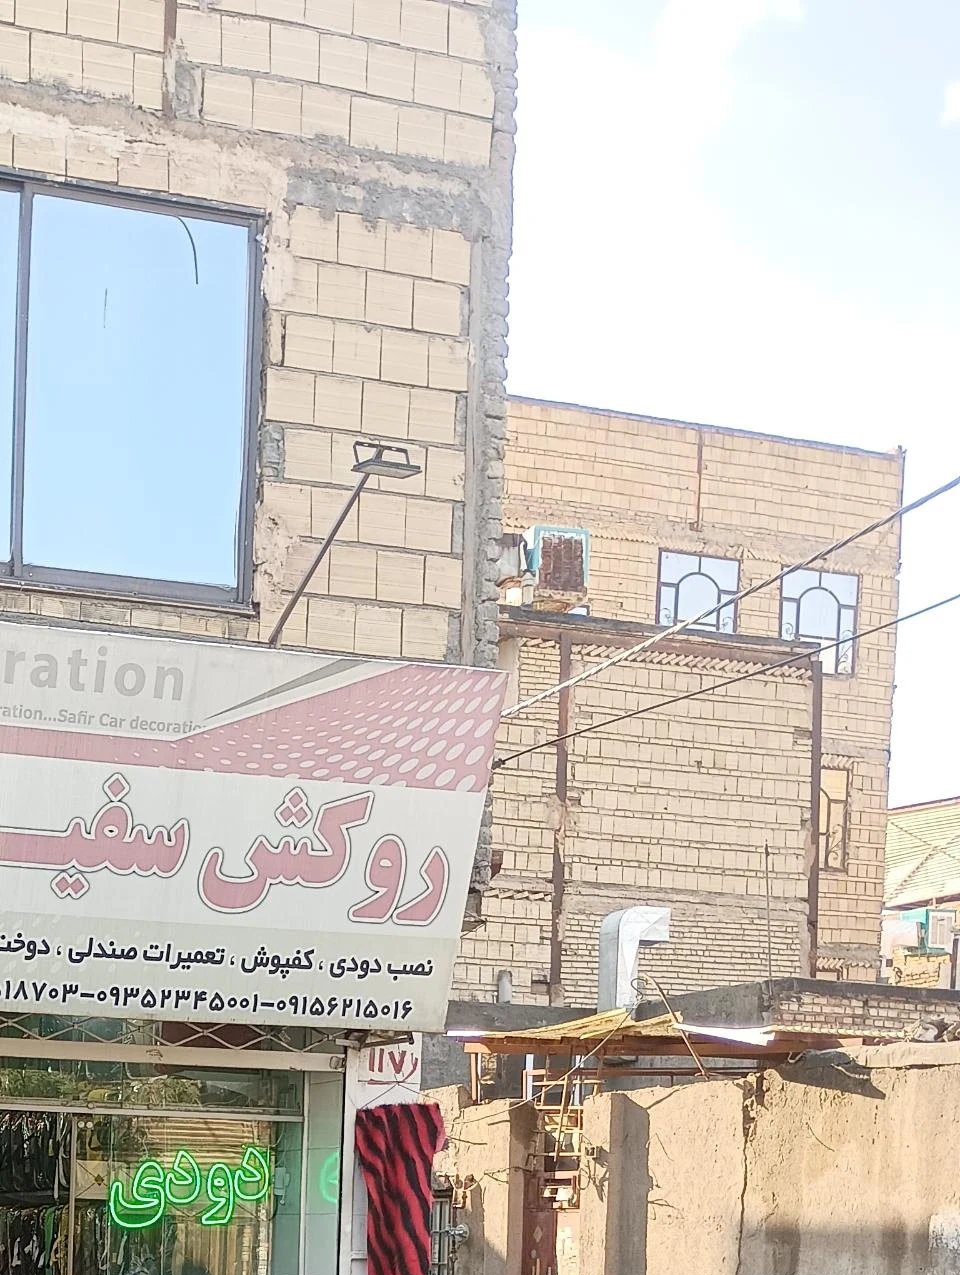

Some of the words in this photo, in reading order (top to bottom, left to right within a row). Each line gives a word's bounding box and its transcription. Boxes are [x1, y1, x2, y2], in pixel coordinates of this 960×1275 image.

[98, 713, 126, 730] Car
[130, 715, 208, 735] decoratio
[198, 786, 450, 927] روکش
[142, 943, 225, 971] تعمیرات
[386, 958, 434, 982] نصب
[109, 1146, 270, 1229] دودی
